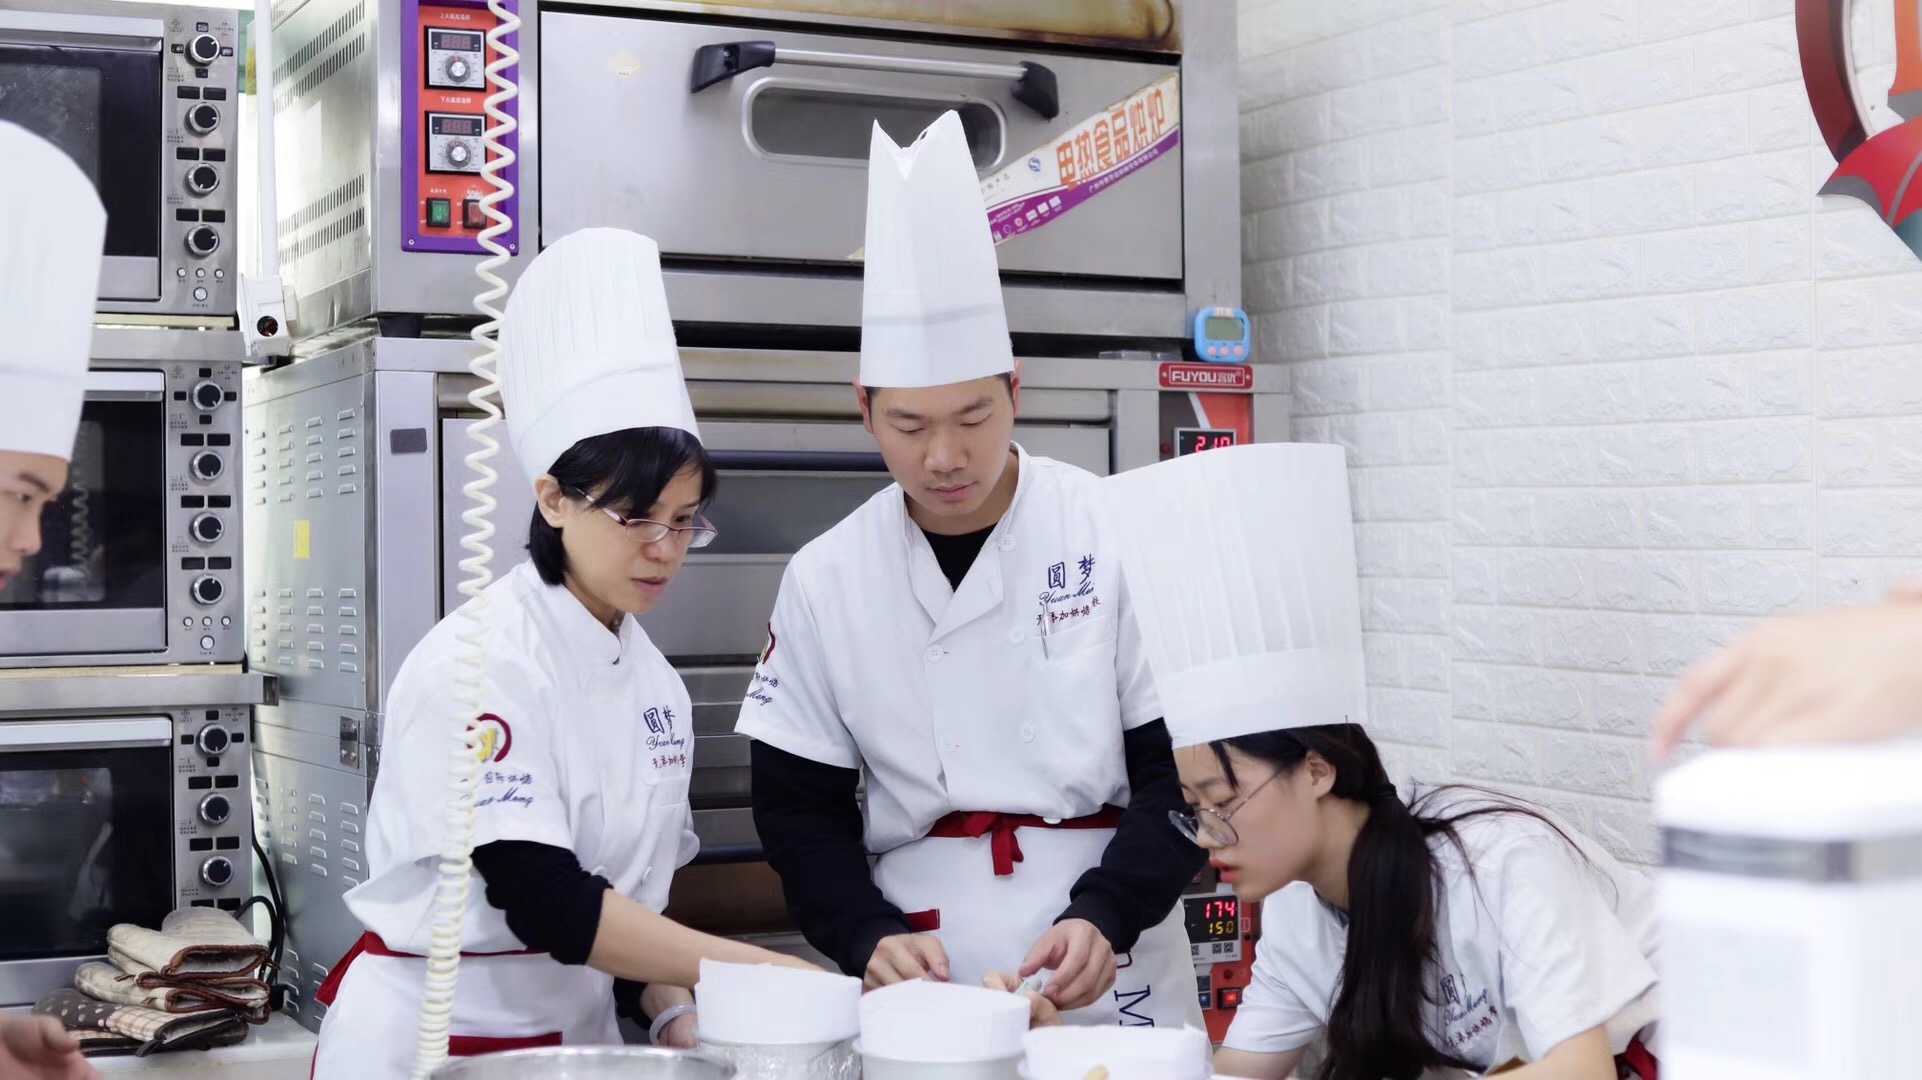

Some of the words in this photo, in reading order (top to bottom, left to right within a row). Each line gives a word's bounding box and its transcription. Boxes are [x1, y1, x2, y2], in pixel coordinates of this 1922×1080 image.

[1172, 370, 1217, 383] FUYOU
[1047, 553, 1096, 590] 圆梦
[643, 704, 677, 735] 圆梦
[1206, 901, 1235, 919] 174
[1209, 921, 1234, 934] 150
